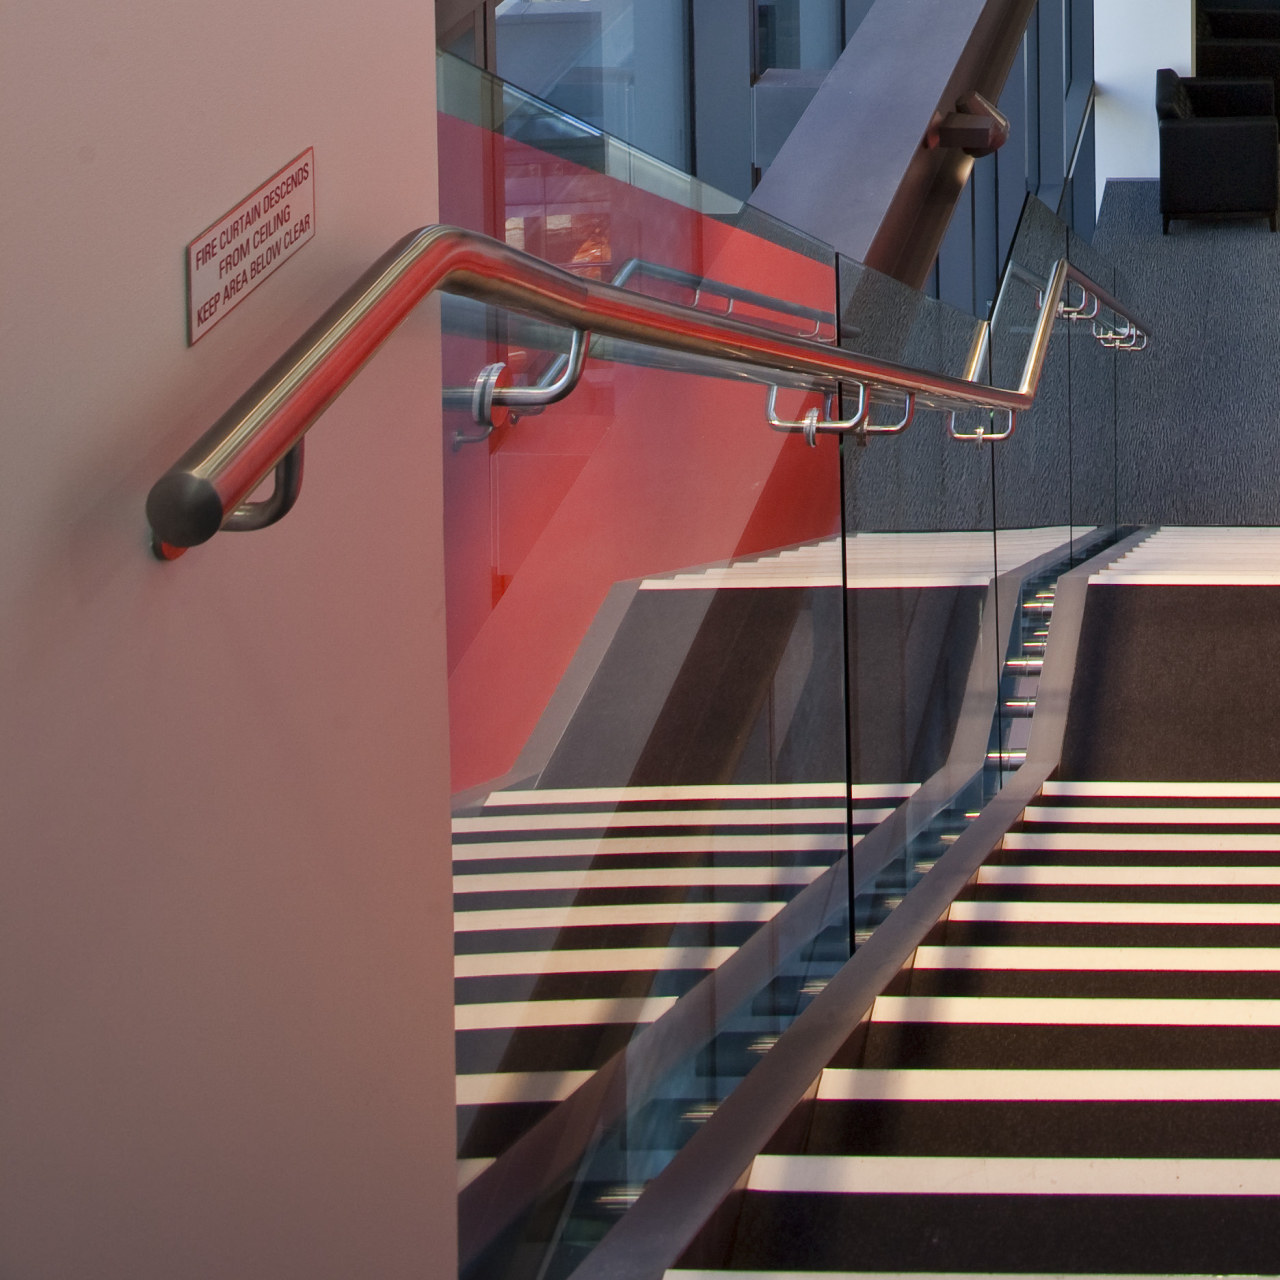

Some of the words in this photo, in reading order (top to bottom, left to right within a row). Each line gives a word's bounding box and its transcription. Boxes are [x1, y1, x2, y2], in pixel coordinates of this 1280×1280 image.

[195, 237, 218, 271] FIRE
[220, 200, 261, 250] CURTAIN
[263, 162, 309, 214] DESCENDS
[197, 291, 220, 328] KEEP
[222, 268, 248, 305] AREA
[250, 237, 281, 280] BELOW
[284, 213, 310, 251] CLEAR
[219, 237, 250, 280] FROM
[253, 204, 290, 249] CEILING
